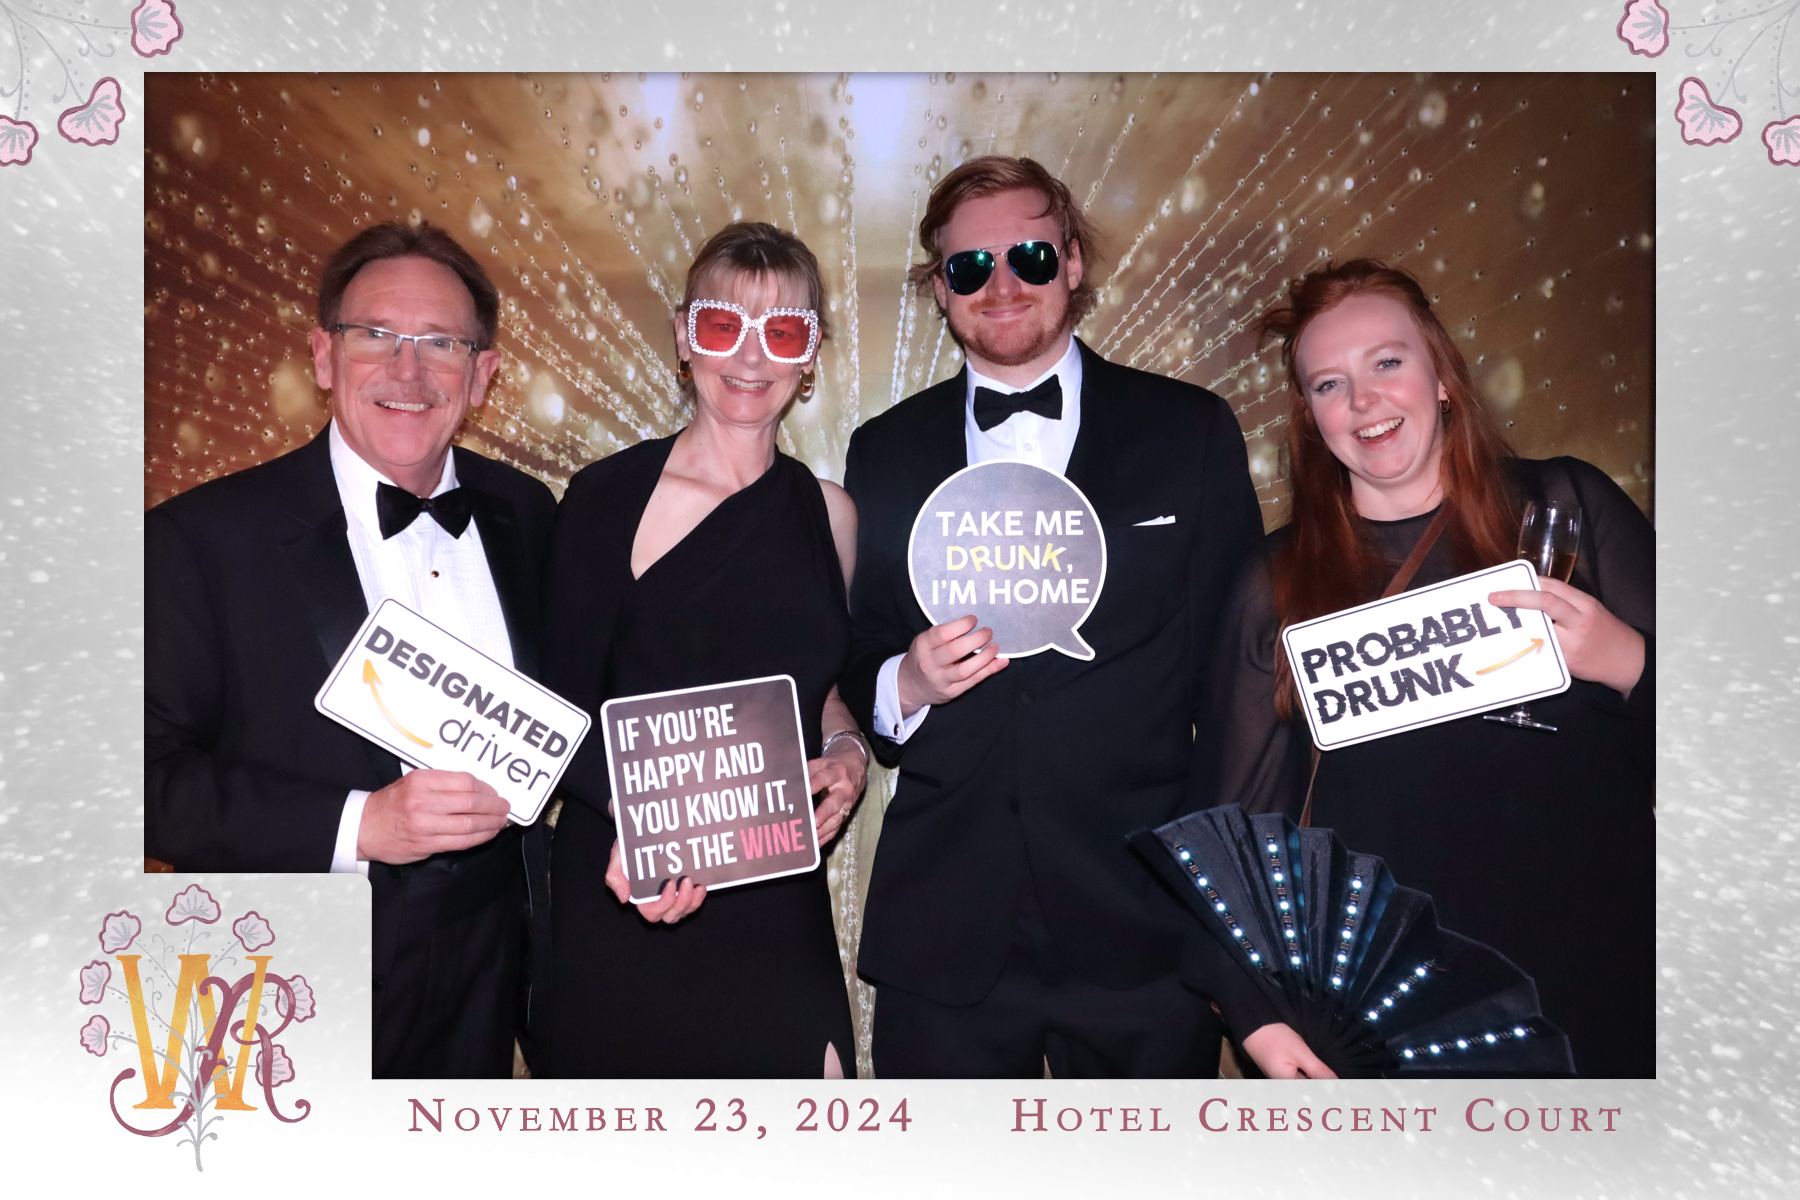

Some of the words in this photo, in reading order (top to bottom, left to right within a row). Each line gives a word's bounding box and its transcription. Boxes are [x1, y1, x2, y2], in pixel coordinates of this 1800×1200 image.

[936, 511, 1024, 536] TAKE
[1035, 510, 1083, 536] ME
[946, 543, 1073, 574] DRUNK,
[932, 579, 977, 605] I'M
[989, 578, 1089, 605] HOME
[1300, 602, 1523, 684] PROBABLY
[364, 625, 568, 758] DESIGNATED
[1312, 653, 1475, 725] DRUNK
[439, 719, 550, 790] driver
[617, 717, 640, 752] IF
[645, 703, 737, 747] YOU'RE
[622, 750, 706, 795] HAPPY
[715, 742, 765, 780] AND
[627, 798, 680, 837] YOU
[685, 784, 759, 828] KNOW
[765, 779, 794, 814] IT,
[634, 841, 683, 880] IT'S
[686, 831, 737, 870] THE
[740, 818, 806, 860] WINE
